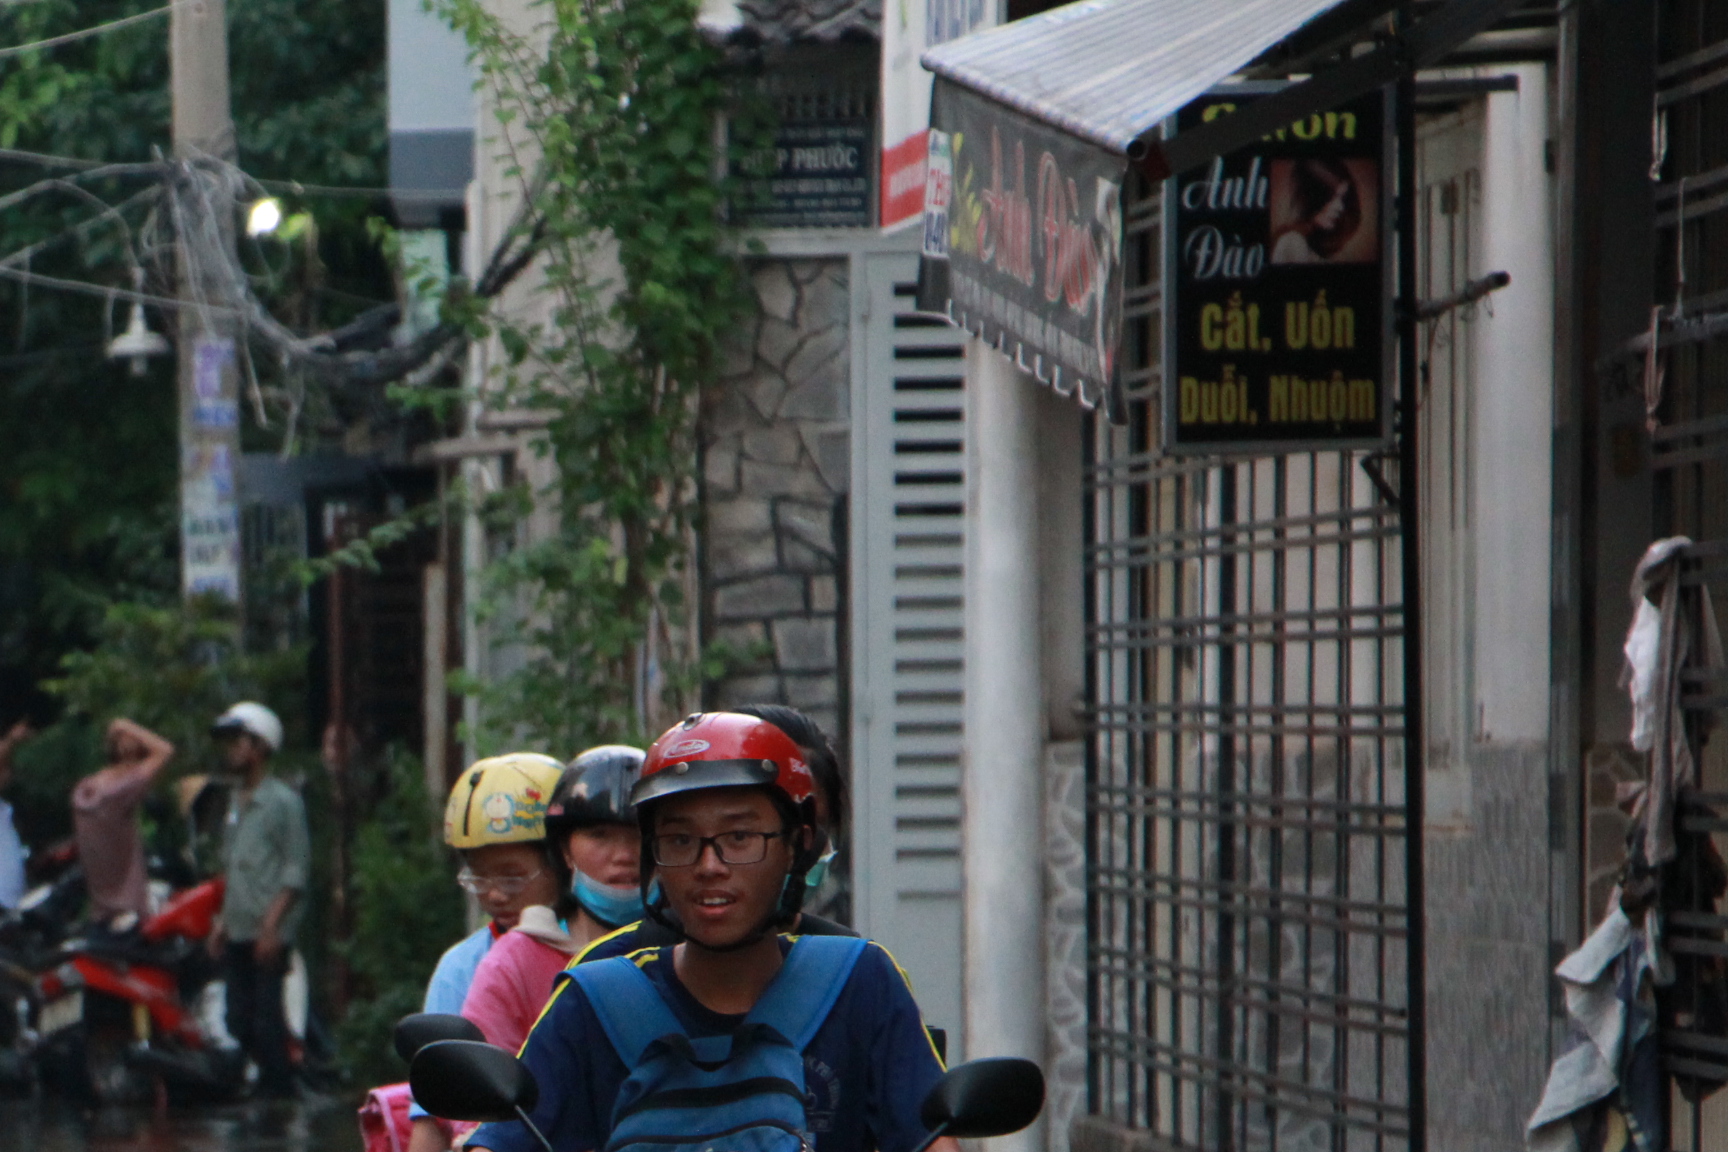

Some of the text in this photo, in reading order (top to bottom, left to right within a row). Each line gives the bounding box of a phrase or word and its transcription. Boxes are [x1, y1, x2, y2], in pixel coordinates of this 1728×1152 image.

[1182, 155, 1268, 209] Anh
[1184, 224, 1264, 280] Đào
[1285, 288, 1354, 349] Uốn
[1269, 370, 1375, 431] Nhuộm
